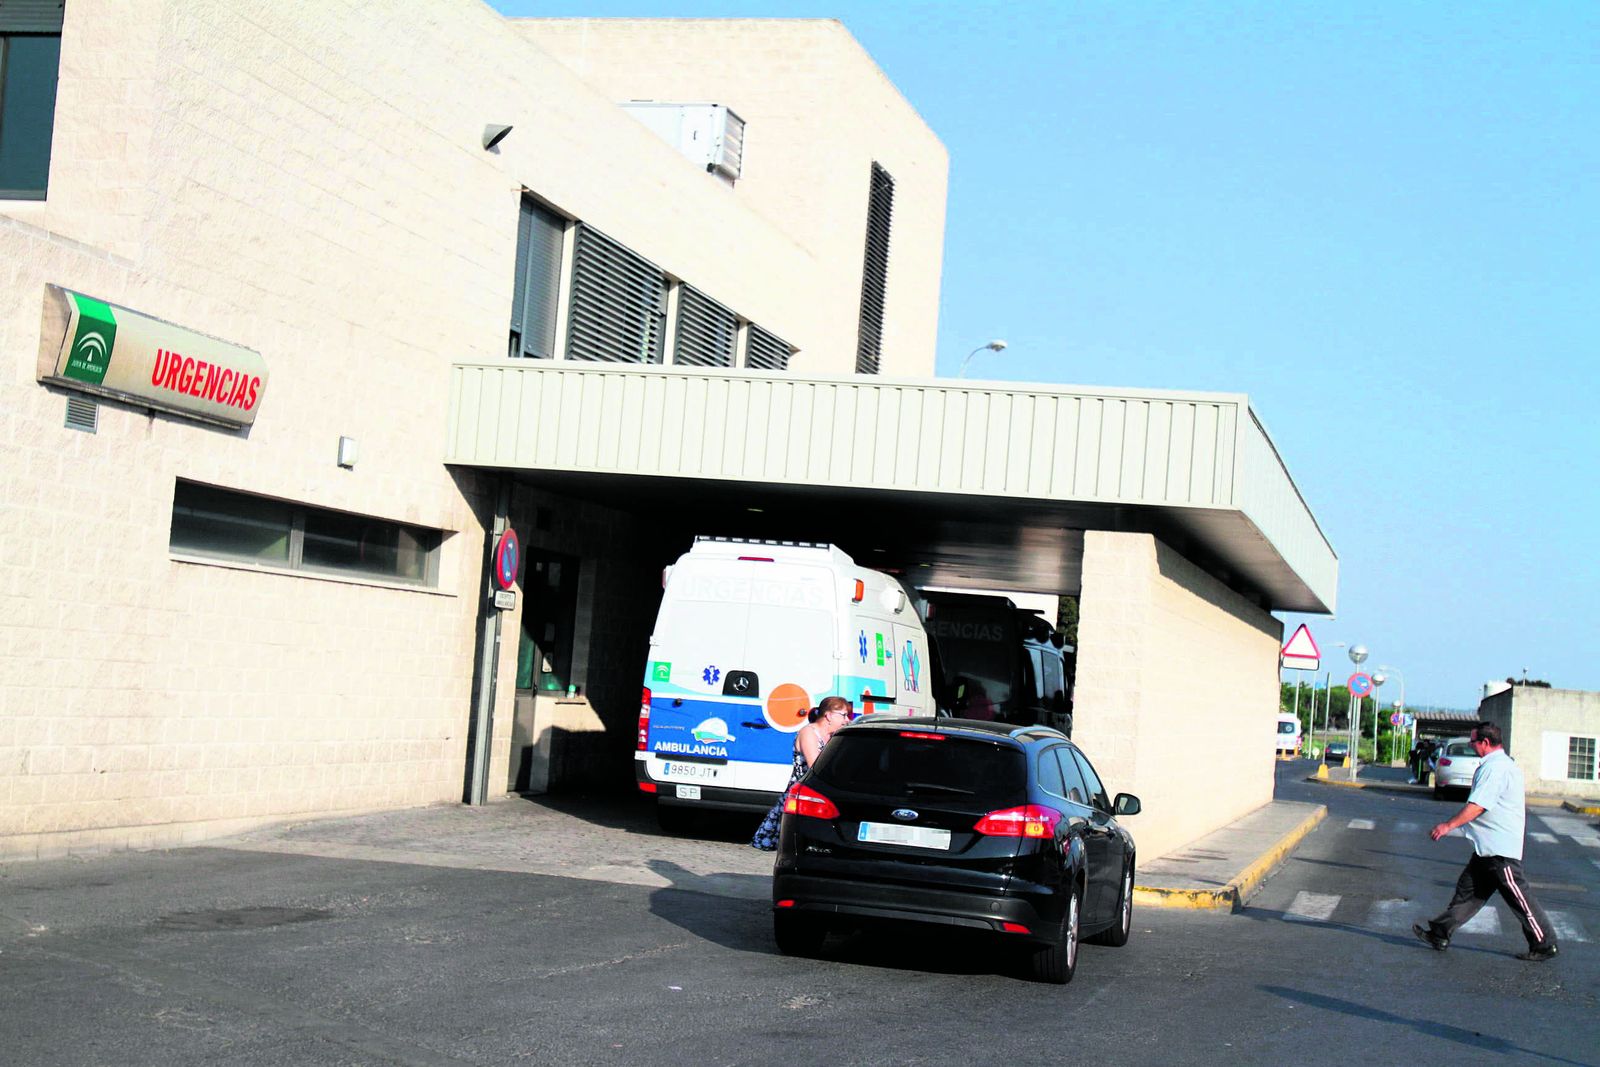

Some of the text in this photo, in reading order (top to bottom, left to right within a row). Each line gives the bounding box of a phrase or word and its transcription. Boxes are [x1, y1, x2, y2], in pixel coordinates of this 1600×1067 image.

[152, 348, 260, 411] URGENCIAS
[681, 576, 825, 607] URGENCIAS
[654, 741, 728, 757] AMBULANCIA
[671, 765, 696, 776] 9850
[679, 787, 698, 797] SP
